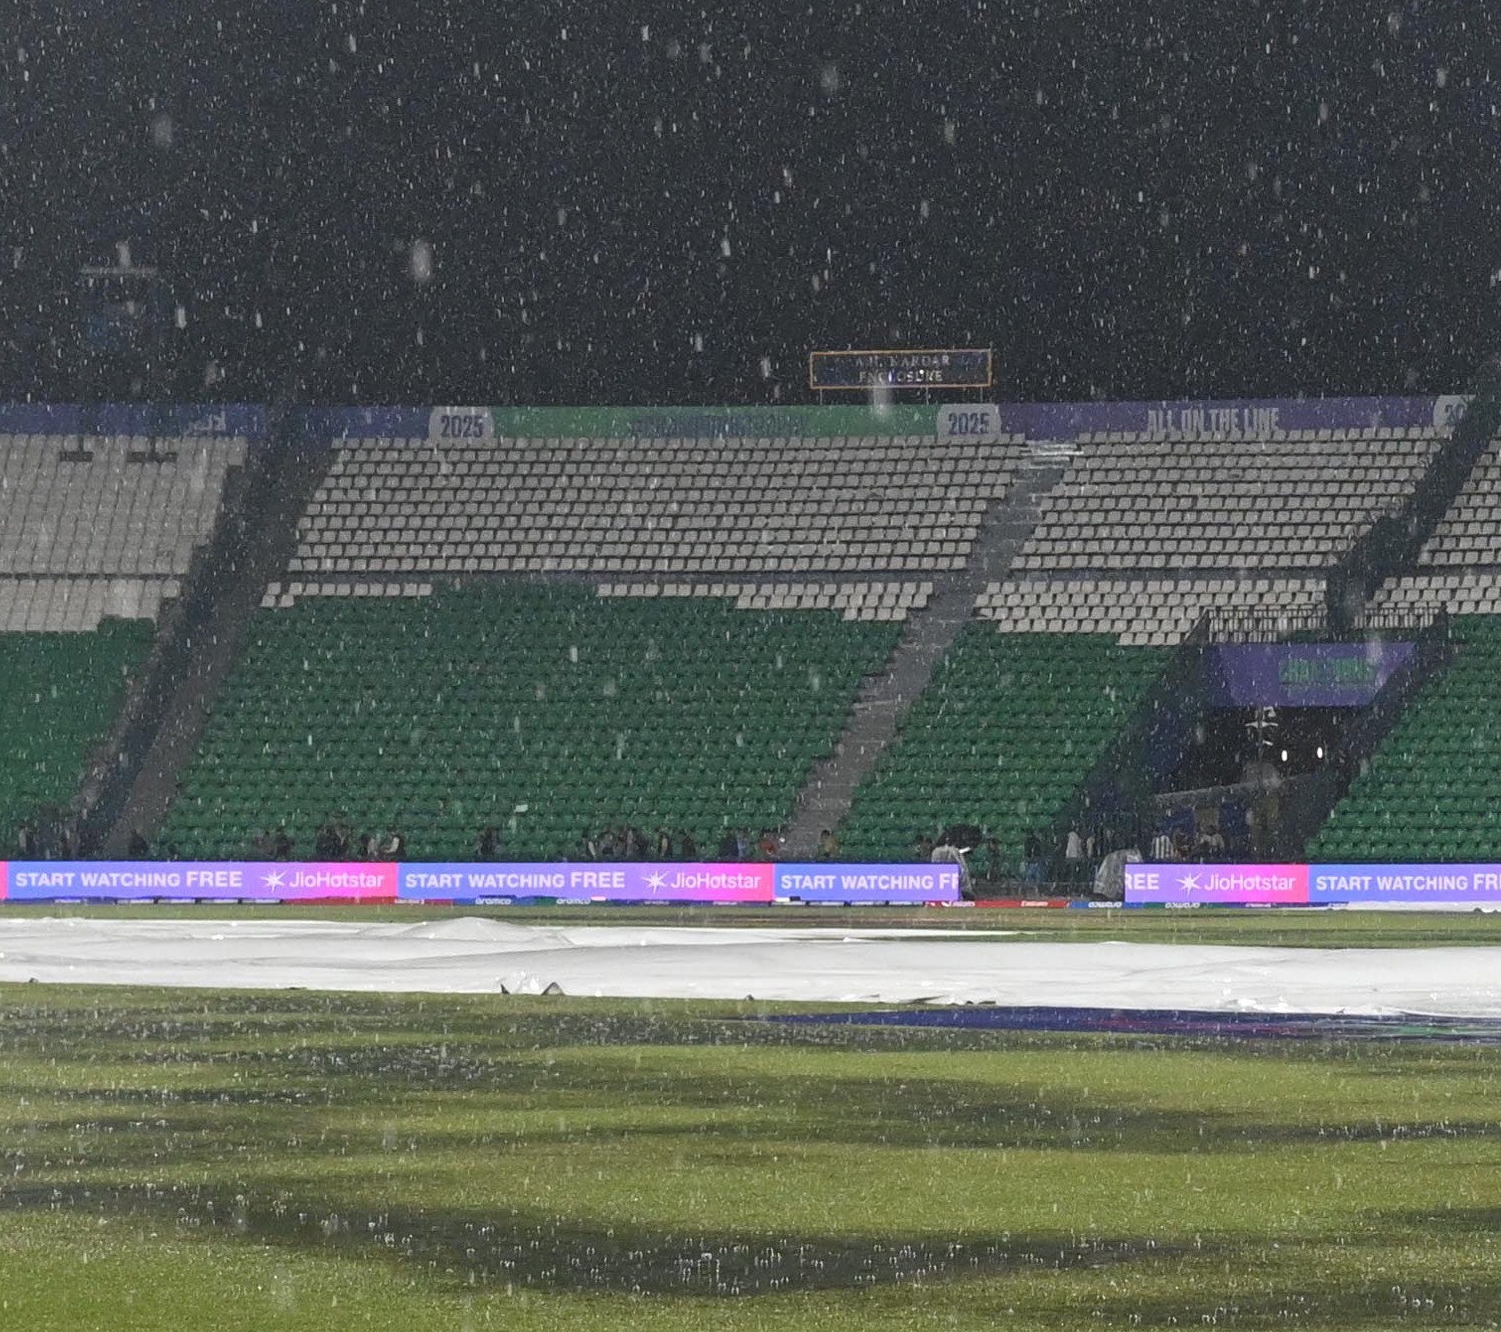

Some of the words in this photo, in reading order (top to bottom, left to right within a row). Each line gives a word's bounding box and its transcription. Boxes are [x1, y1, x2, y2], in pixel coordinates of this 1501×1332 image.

[441, 415, 484, 437] 2025
[948, 413, 990, 435] 2025
[1148, 409, 1178, 433] ALL
[1181, 409, 1204, 433] ON
[1209, 409, 1240, 433] THE
[1244, 407, 1279, 433] LINE
[15, 872, 76, 887] START
[80, 872, 181, 887] WATCHING
[186, 870, 243, 887] FREE
[289, 871, 386, 888] JioHotstar
[405, 873, 464, 888] START
[467, 873, 565, 889] WATCHING
[570, 871, 625, 889] FREE
[670, 872, 762, 889] JioHotstar
[781, 874, 837, 890] START
[840, 874, 934, 890] WATCHING
[1204, 873, 1297, 891] JioHotstar
[1315, 875, 1373, 891] START
[1376, 875, 1469, 891] WATCHING
